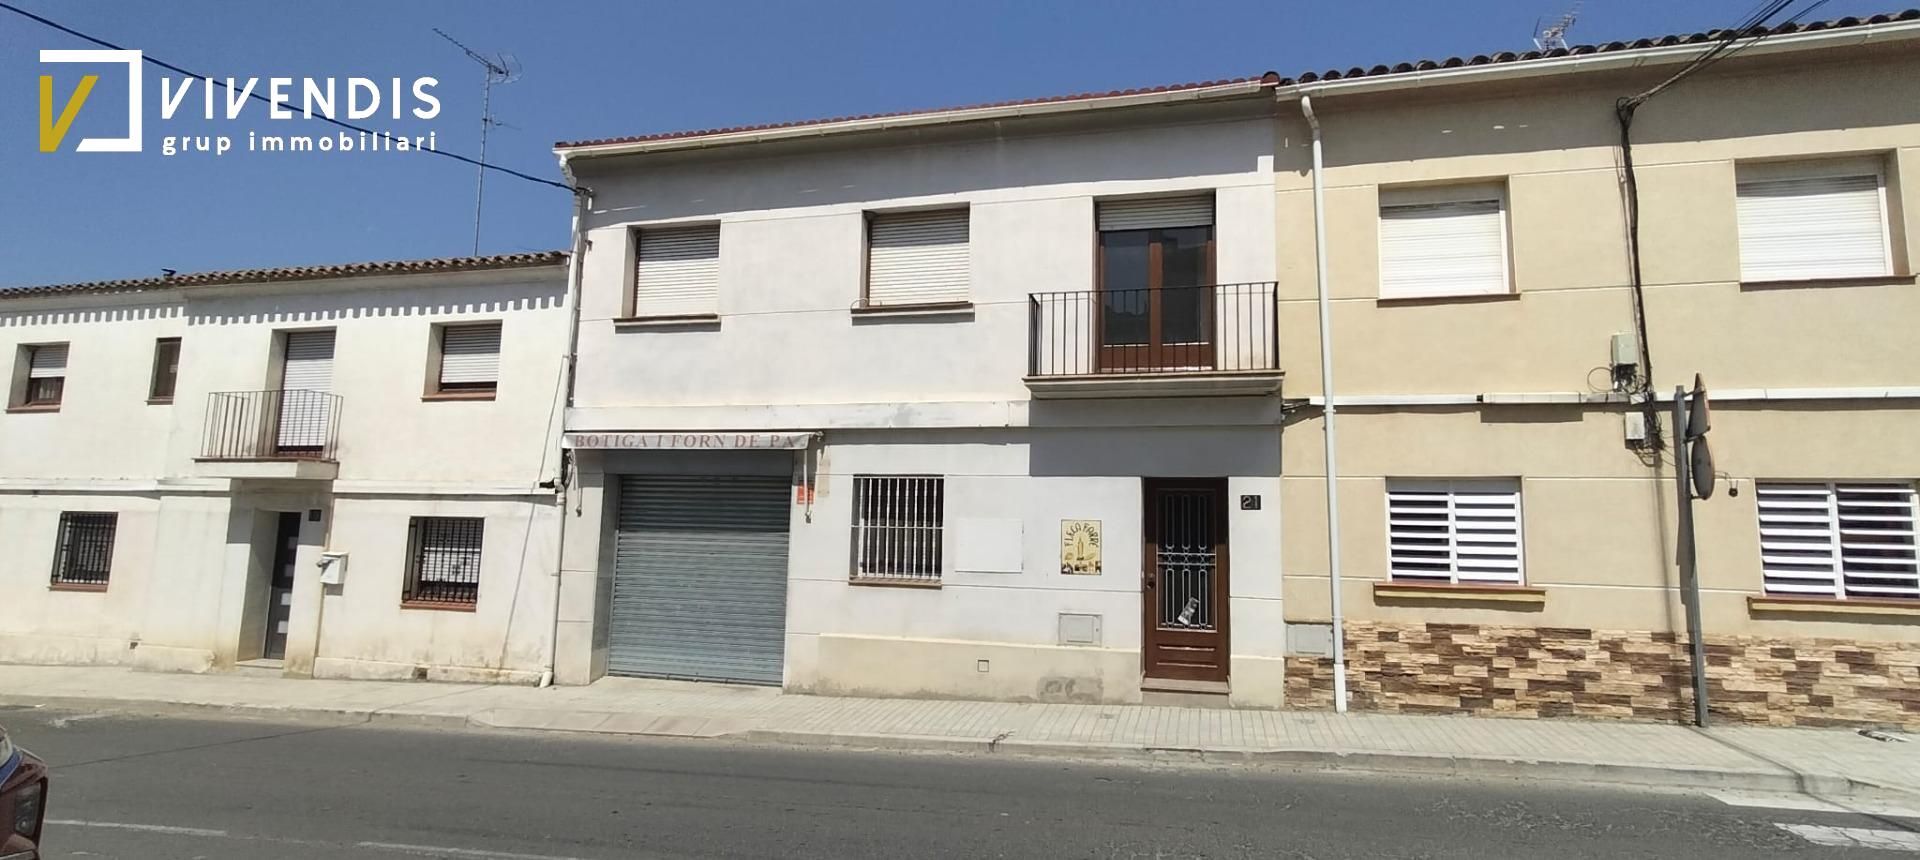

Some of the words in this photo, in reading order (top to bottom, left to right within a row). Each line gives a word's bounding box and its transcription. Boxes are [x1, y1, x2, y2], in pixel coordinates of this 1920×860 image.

[575, 434, 648, 448] BOTIGA
[656, 434, 664, 448] I
[671, 434, 726, 448] FORN
[734, 434, 761, 448] DE
[769, 434, 795, 448] PA
[1242, 495, 1259, 509] 21
